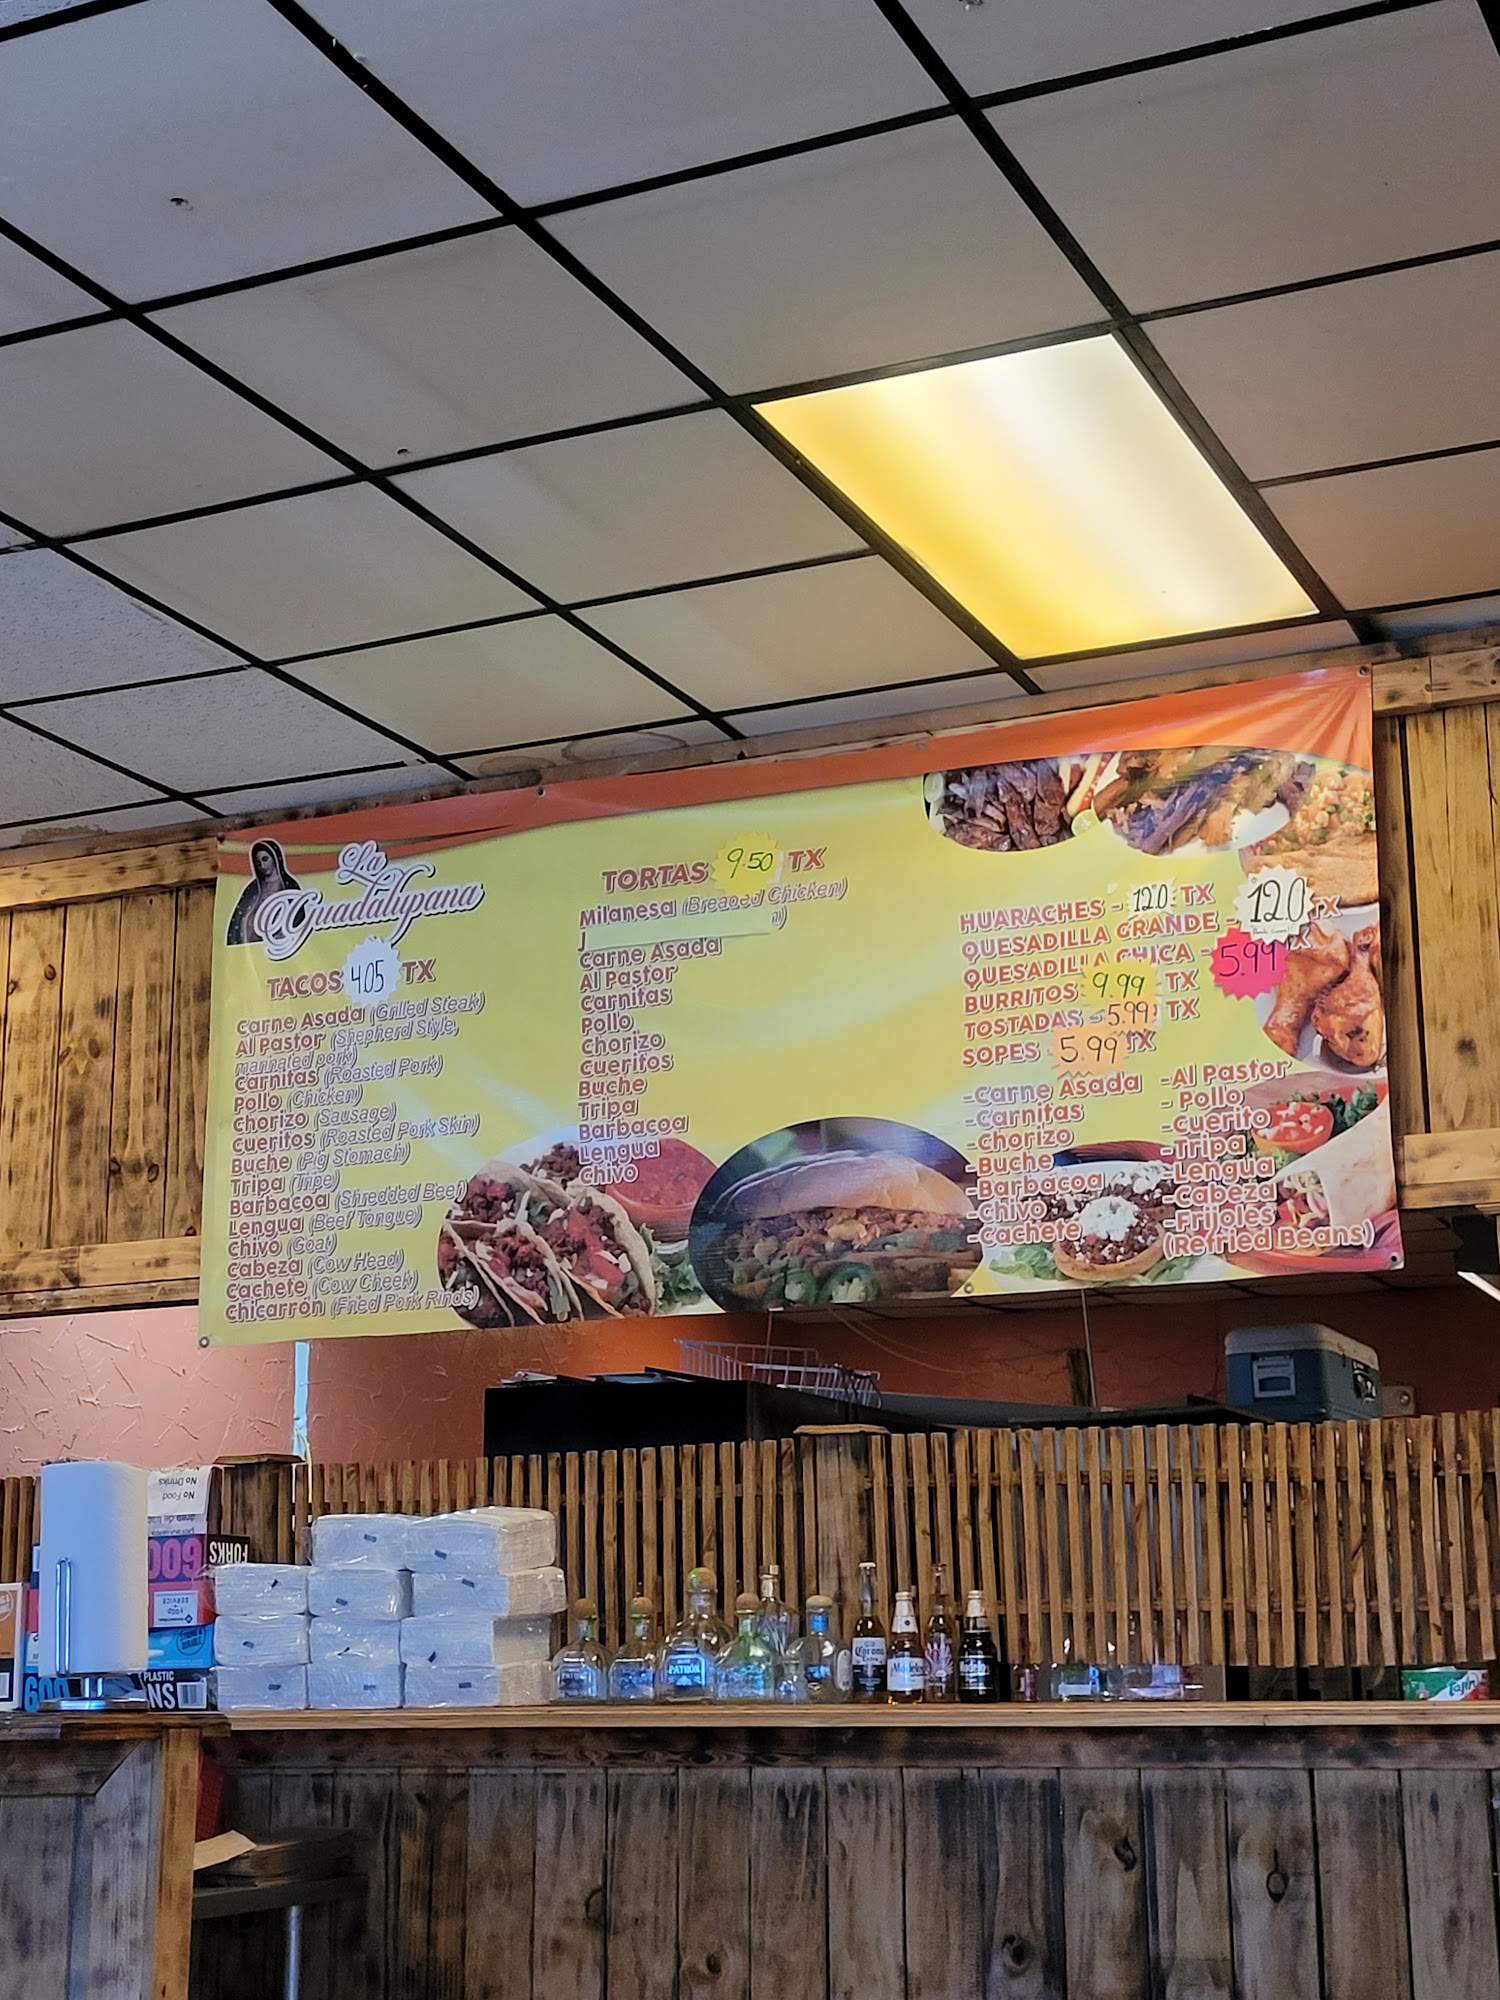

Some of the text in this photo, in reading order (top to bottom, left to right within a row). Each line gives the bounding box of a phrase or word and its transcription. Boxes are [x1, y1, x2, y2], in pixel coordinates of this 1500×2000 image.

[337, 841, 389, 885] La
[726, 847, 774, 880] 9.50
[788, 846, 828, 874] TX
[601, 862, 709, 894] TORTAS
[579, 899, 677, 929] Milanesa
[767, 877, 849, 903] Chicken)
[1180, 882, 1215, 906] TX
[1312, 895, 1342, 919] TX
[254, 864, 484, 960] Guadalupana
[959, 899, 1105, 934] HUARACHES
[961, 925, 1111, 965] QUESADILLA
[1116, 911, 1219, 940] GRANDE
[579, 936, 723, 970] Carne Asada
[1219, 942, 1276, 977] 5.99
[267, 970, 345, 1000] TACOS
[402, 958, 437, 983] TX
[579, 965, 679, 993] Al Pastor
[1093, 971, 1145, 999] 9.99
[1165, 969, 1200, 992] TX
[580, 987, 673, 1014] Carnitas
[964, 982, 1078, 1015] BURRITOS
[1166, 998, 1200, 1020] TX
[237, 992, 485, 1036] Carne Asada (Grilled Steak)
[581, 1012, 634, 1036] Pollo
[963, 1009, 1084, 1041] TOSTADAS
[1107, 1001, 1149, 1026] 5.99
[236, 1016, 459, 1058] Al Pastor (Shepherd Style,
[581, 1030, 666, 1057] Chorizo
[1060, 1035, 1118, 1064] 5.99
[235, 1046, 357, 1076] marinated pork)
[579, 1051, 674, 1078] Cueritos
[962, 1042, 1040, 1068] SOPES
[235, 1054, 443, 1094] Carnitas (Roasted Pork)
[1060, 1073, 1143, 1099] Asada
[1203, 1059, 1291, 1084] Pastor
[233, 1084, 363, 1115] Pollo (Chicken)
[578, 1076, 648, 1099] Buche
[1179, 1086, 1244, 1111] Pollo
[232, 1101, 397, 1134] Chorizo (Sausage)
[578, 1097, 639, 1121] Tripa
[232, 1113, 480, 1155] Cueritos (Roasted Pork Skin)
[578, 1115, 690, 1142] Barbacoa
[231, 1142, 411, 1176] Buche (Pig Stomach)
[578, 1139, 662, 1166] Lengua
[230, 1169, 340, 1198] Tripa (Tripe)
[578, 1161, 639, 1186] Chivo
[230, 1179, 468, 1218] Barbacoa (Shredded Beef)
[228, 1205, 422, 1239] Lengua (Beef Tongue)
[228, 1233, 337, 1260] Chivo (Goat)
[1163, 1218, 1375, 1260] (Refried Beans)
[227, 1249, 404, 1280] Cabeza (Cow Head)
[226, 1271, 418, 1302] Cachete (Cow Cheek)
[330, 1293, 382, 1320] (Fried
[382, 1292, 424, 1313] Pork
[425, 1285, 480, 1311] Rinds)
[209, 1541, 248, 1564] FORKS
[143, 1670, 175, 1682] PLASTIC
[147, 1683, 176, 1709] NS
